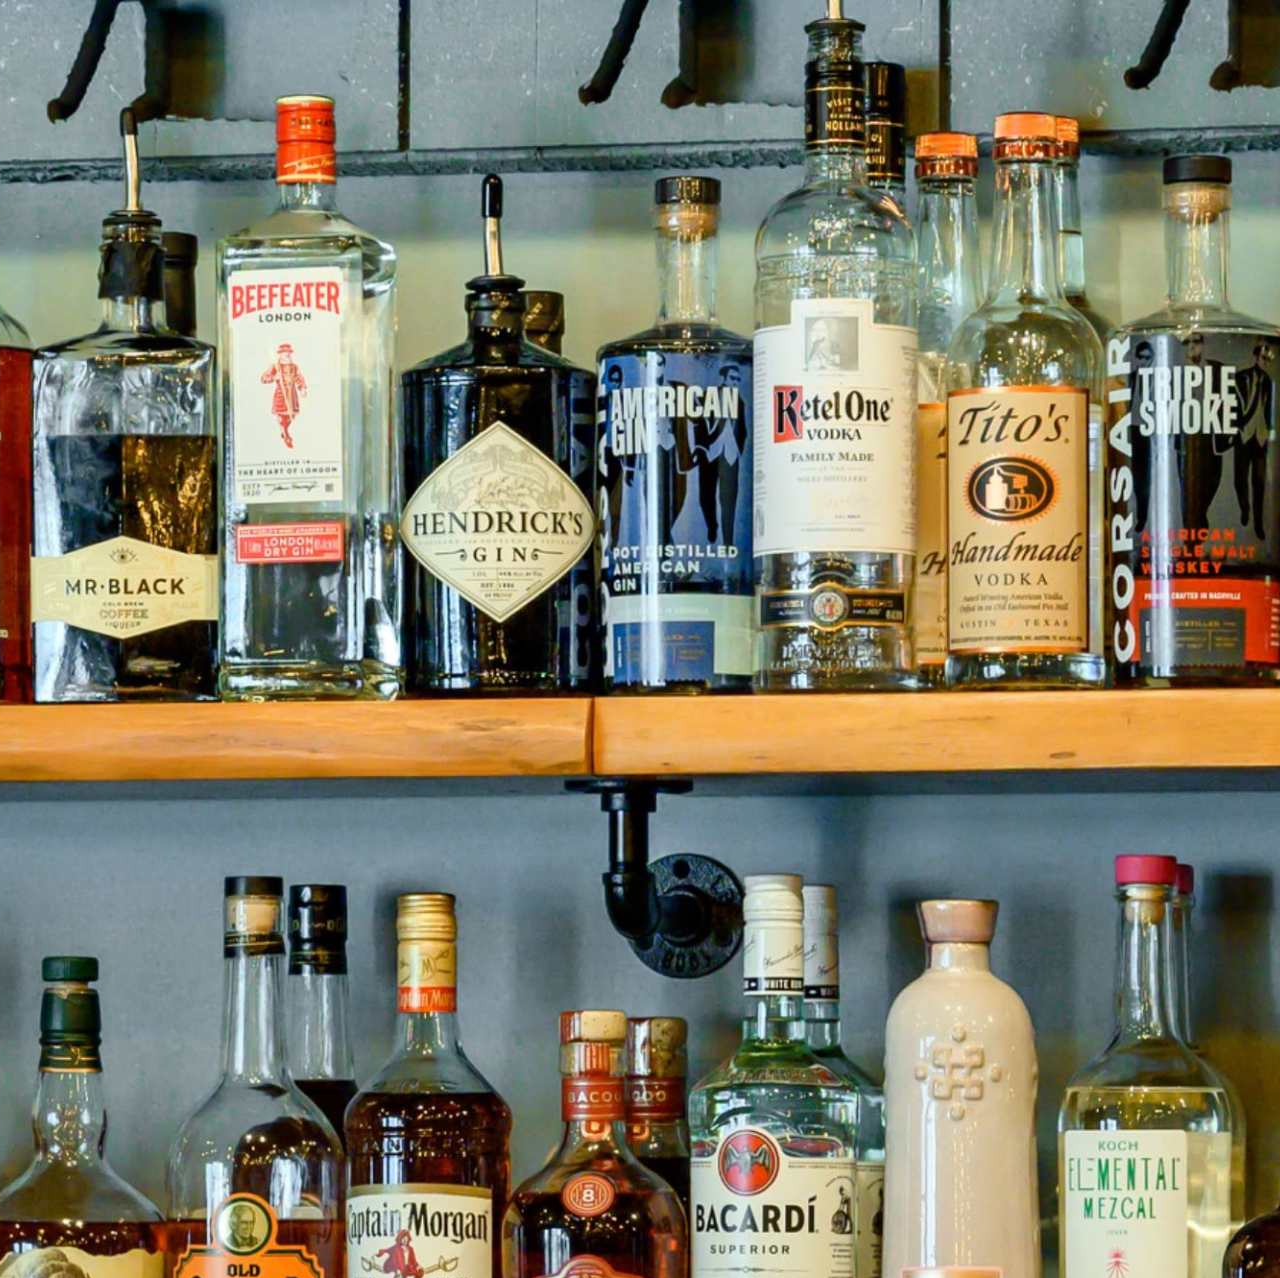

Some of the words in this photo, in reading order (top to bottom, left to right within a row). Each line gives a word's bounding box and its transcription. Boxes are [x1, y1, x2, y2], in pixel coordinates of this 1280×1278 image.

[232, 281, 340, 319] BEEFEATER
[258, 312, 312, 323] LONDON
[1138, 364, 1238, 402] TRIPLE
[611, 386, 740, 421] AMERICAN
[773, 385, 843, 442] Ketel
[844, 389, 893, 423] One
[1138, 398, 1239, 438] SMOKE
[958, 400, 1069, 447] Tito's
[612, 417, 650, 457] GIN
[805, 428, 863, 441] VODKA
[790, 453, 836, 464] FAMILY
[838, 452, 875, 463] MADE
[1108, 335, 1136, 664] CORSAIR
[412, 508, 585, 537] HENDRICK'S
[263, 537, 315, 547] LONDON
[950, 531, 1083, 567] Handmade
[263, 547, 289, 558] DRY
[291, 546, 314, 556] GIN
[473, 546, 528, 563] GIN
[613, 546, 639, 561] POT
[613, 577, 637, 593] GIN
[973, 572, 1049, 586] VODKA
[99, 608, 149, 620] COFFEE
[1023, 618, 1069, 627] TEXAS
[1097, 1140, 1140, 1152] KOCH
[1068, 1156, 1178, 1192] ELEMENTAL
[581, 1188, 595, 1204] 8
[695, 1195, 816, 1236] BACARDÍ
[1083, 1196, 1157, 1220] MEZCAL
[405, 1200, 489, 1245] Morgan
[709, 1243, 791, 1256] SUPERIOR
[227, 1263, 261, 1278] OLD
